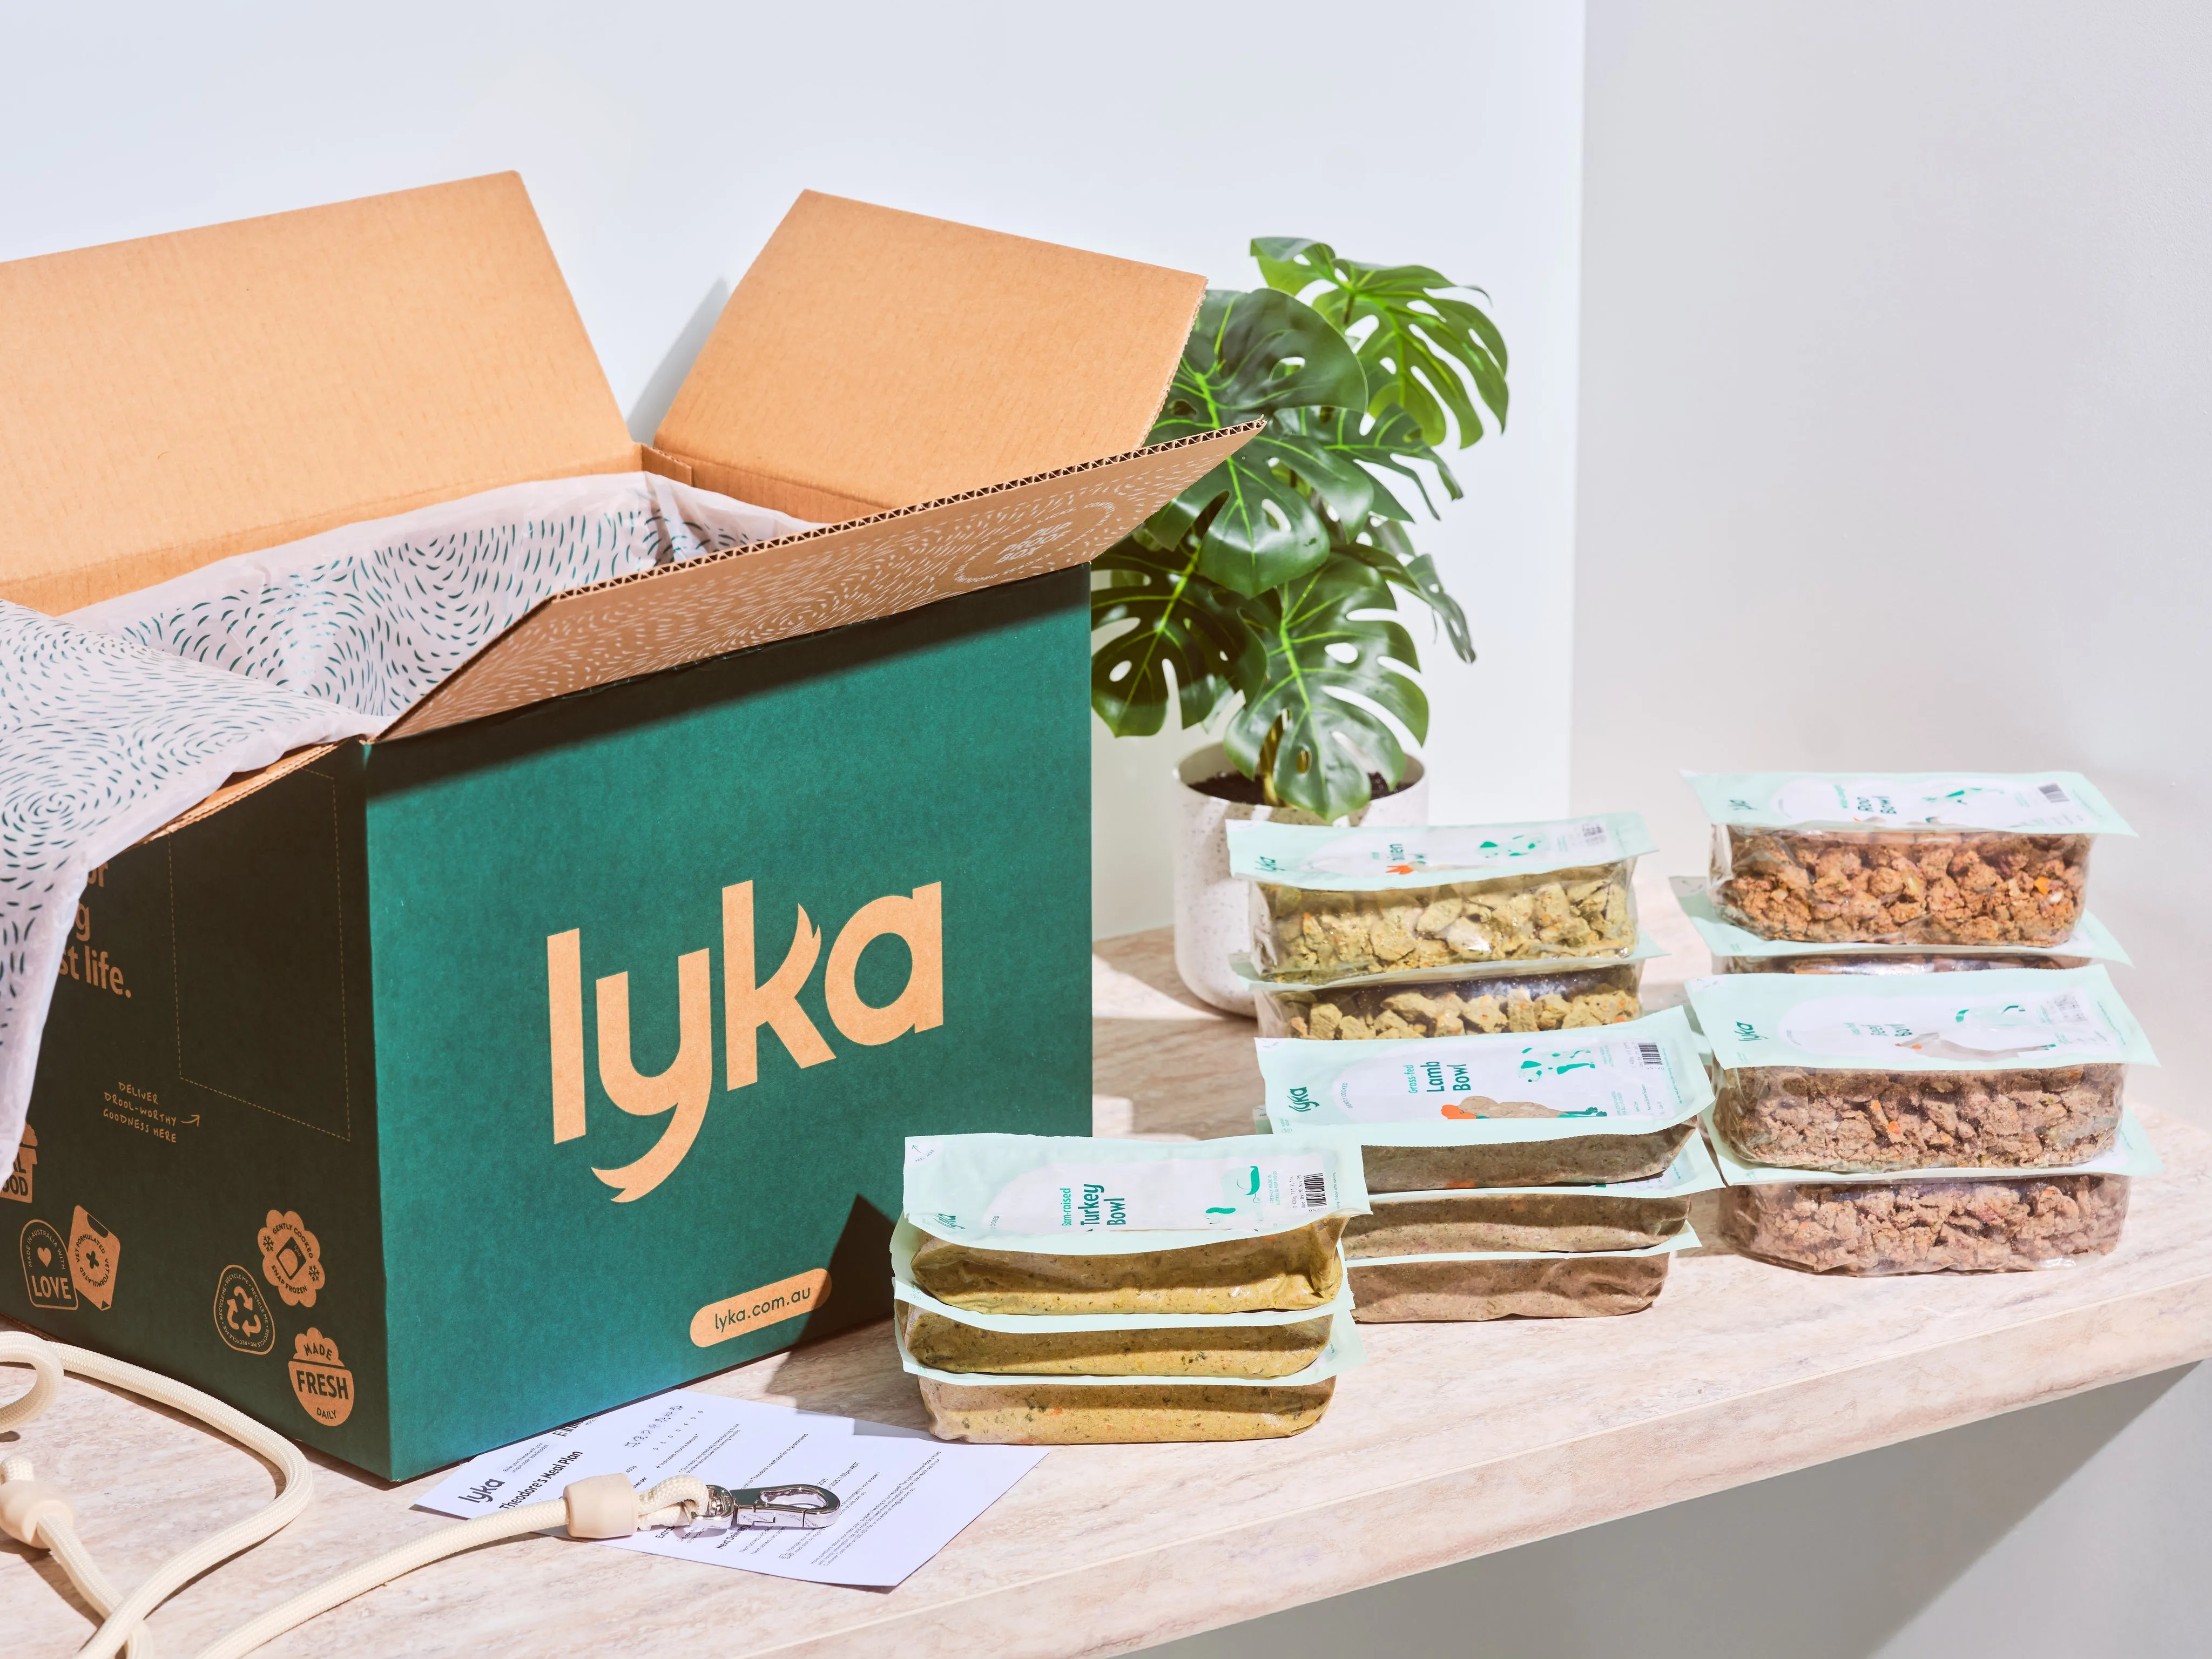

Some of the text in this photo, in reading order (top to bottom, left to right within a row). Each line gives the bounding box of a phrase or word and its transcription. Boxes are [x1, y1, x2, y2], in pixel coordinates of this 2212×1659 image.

[996, 529, 1072, 556] PROOF
[1026, 521, 1074, 541] PUP
[994, 544, 1044, 565] BOX
[84, 945, 132, 999] life.
[547, 879, 943, 1203] lyka
[1735, 1021, 1769, 1042] lyka
[1884, 1023, 1913, 1037] Bowl
[1403, 1065, 1418, 1094] Grass-fed
[1420, 1061, 1445, 1092] Lamb
[1447, 1064, 1471, 1091] Bowl
[118, 1082, 158, 1105] DELIVER
[1287, 1087, 1320, 1112] lyka
[1342, 1097, 1353, 1109] GENTLY
[104, 1091, 177, 1127] DROOL-WORTHY
[103, 1108, 177, 1143] GOODNESS HERE
[1060, 1188, 1072, 1226] Barn-raised
[1078, 1184, 1104, 1226] Turkey
[1103, 1198, 1127, 1225] Bowl
[933, 1213, 966, 1229] lyka
[27, 1237, 33, 1245] IN
[31, 1229, 57, 1248] AUSTRALIA
[57, 1249, 65, 1269] WITH
[77, 1233, 105, 1254] FORMULATED
[272, 1223, 313, 1258] GENTLY COOKED
[31, 1275, 71, 1299] LOVE
[80, 1267, 109, 1287] FORMULATED
[225, 1272, 241, 1284] RECYCLE
[242, 1276, 249, 1285] ME
[271, 1264, 307, 1294] SNAP FROZEN
[221, 1286, 227, 1296] ME
[251, 1287, 265, 1313] RECYCLE
[263, 1313, 268, 1323] ME
[715, 1287, 810, 1333] lyka.com.au
[222, 1325, 230, 1335] ME
[229, 1333, 247, 1346] RECYCLE
[258, 1328, 269, 1347] RECYCLE
[304, 1342, 333, 1361] MADE
[296, 1370, 349, 1400] FRESH
[316, 1407, 337, 1420] DAILY
[458, 1479, 504, 1502] lyka
[499, 1451, 582, 1508] Theodore's Meal Plan
[655, 1526, 676, 1538] Extras
[717, 1524, 752, 1548] Next Delivery
